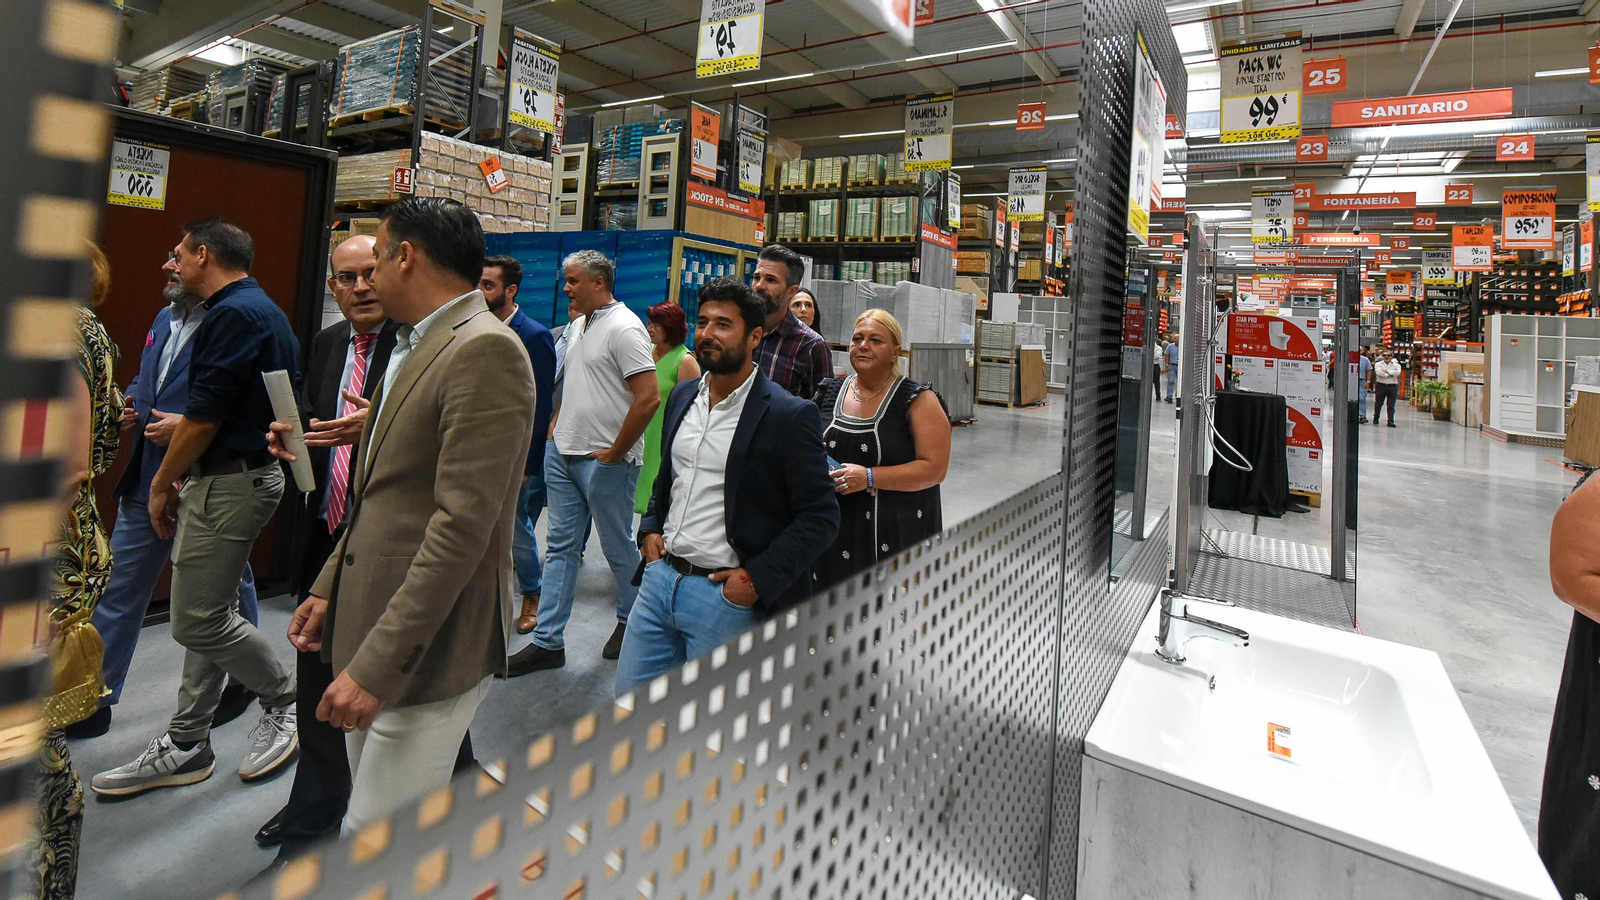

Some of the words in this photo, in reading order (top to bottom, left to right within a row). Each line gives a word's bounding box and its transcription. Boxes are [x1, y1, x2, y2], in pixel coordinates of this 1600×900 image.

[1222, 45, 1258, 55] UNIDADES
[1260, 40, 1300, 50] LIMITADAS
[1238, 56, 1264, 74] PACK
[1267, 54, 1282, 70] WC
[1309, 68, 1341, 86] 25
[1253, 85, 1268, 94] TEKA
[1361, 99, 1468, 118] SANITARIO
[1249, 132, 1263, 140] 108
[1300, 142, 1324, 155] 23
[1501, 141, 1529, 155] 24
[1295, 188, 1311, 198] 21
[1448, 190, 1470, 200] 22
[1323, 196, 1400, 206] FONTANERÍA
[1503, 193, 1557, 204] COMPOSICION
[1416, 217, 1433, 226] 20
[1393, 240, 1406, 248] 18
